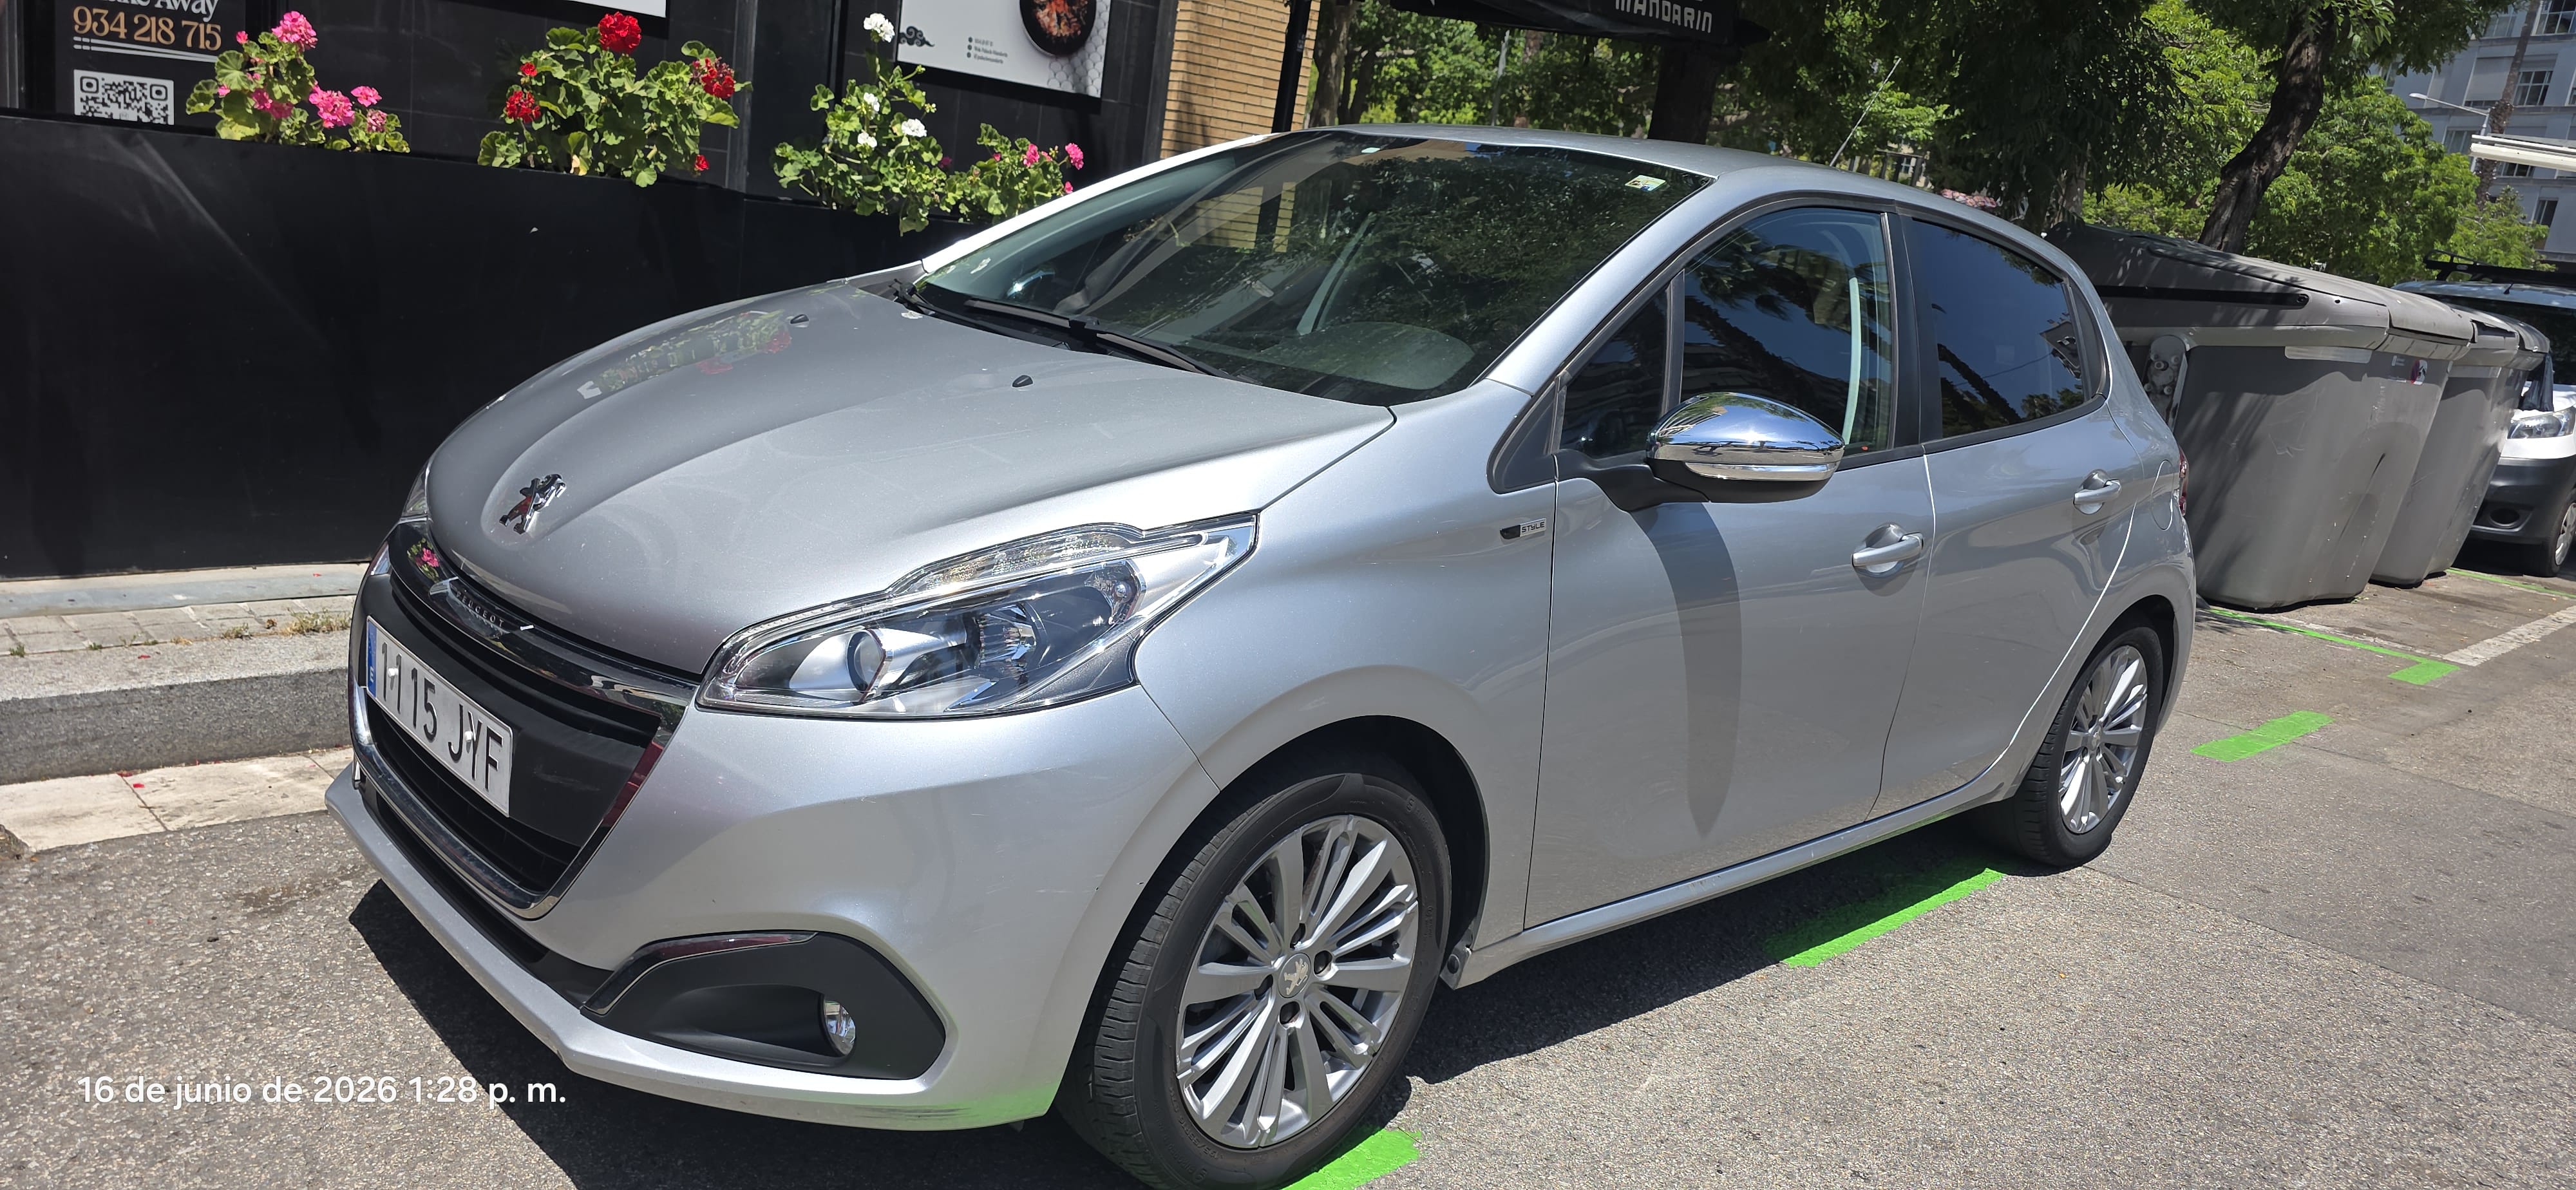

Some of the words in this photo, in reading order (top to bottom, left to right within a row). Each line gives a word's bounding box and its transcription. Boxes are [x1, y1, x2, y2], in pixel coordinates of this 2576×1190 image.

[73, 6, 128, 39] 934
[133, 14, 175, 44] 218
[181, 21, 222, 51] 715
[1521, 522, 1545, 533] STYLE
[456, 591, 504, 628] PEUGEOT
[370, 667, 374, 683] E
[382, 642, 437, 741] 1115
[448, 704, 504, 793] JYF
